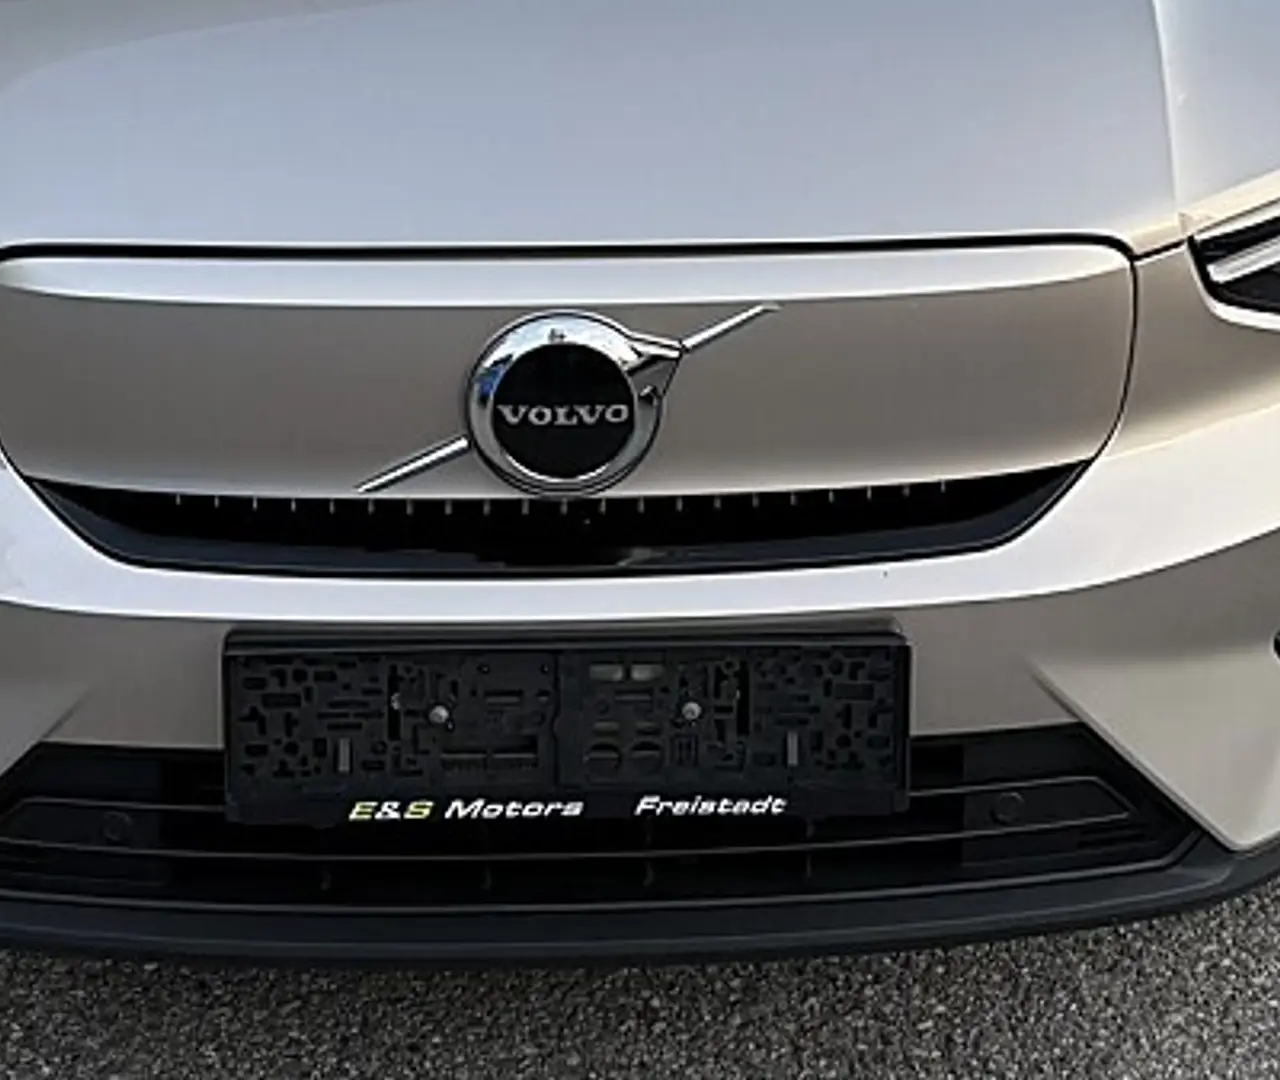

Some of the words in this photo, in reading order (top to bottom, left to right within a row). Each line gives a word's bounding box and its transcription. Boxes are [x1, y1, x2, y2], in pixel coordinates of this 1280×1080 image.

[497, 404, 630, 426] VOLVO
[348, 799, 434, 821] E&S
[443, 797, 585, 820] Motors
[633, 794, 788, 817] Freistadt
